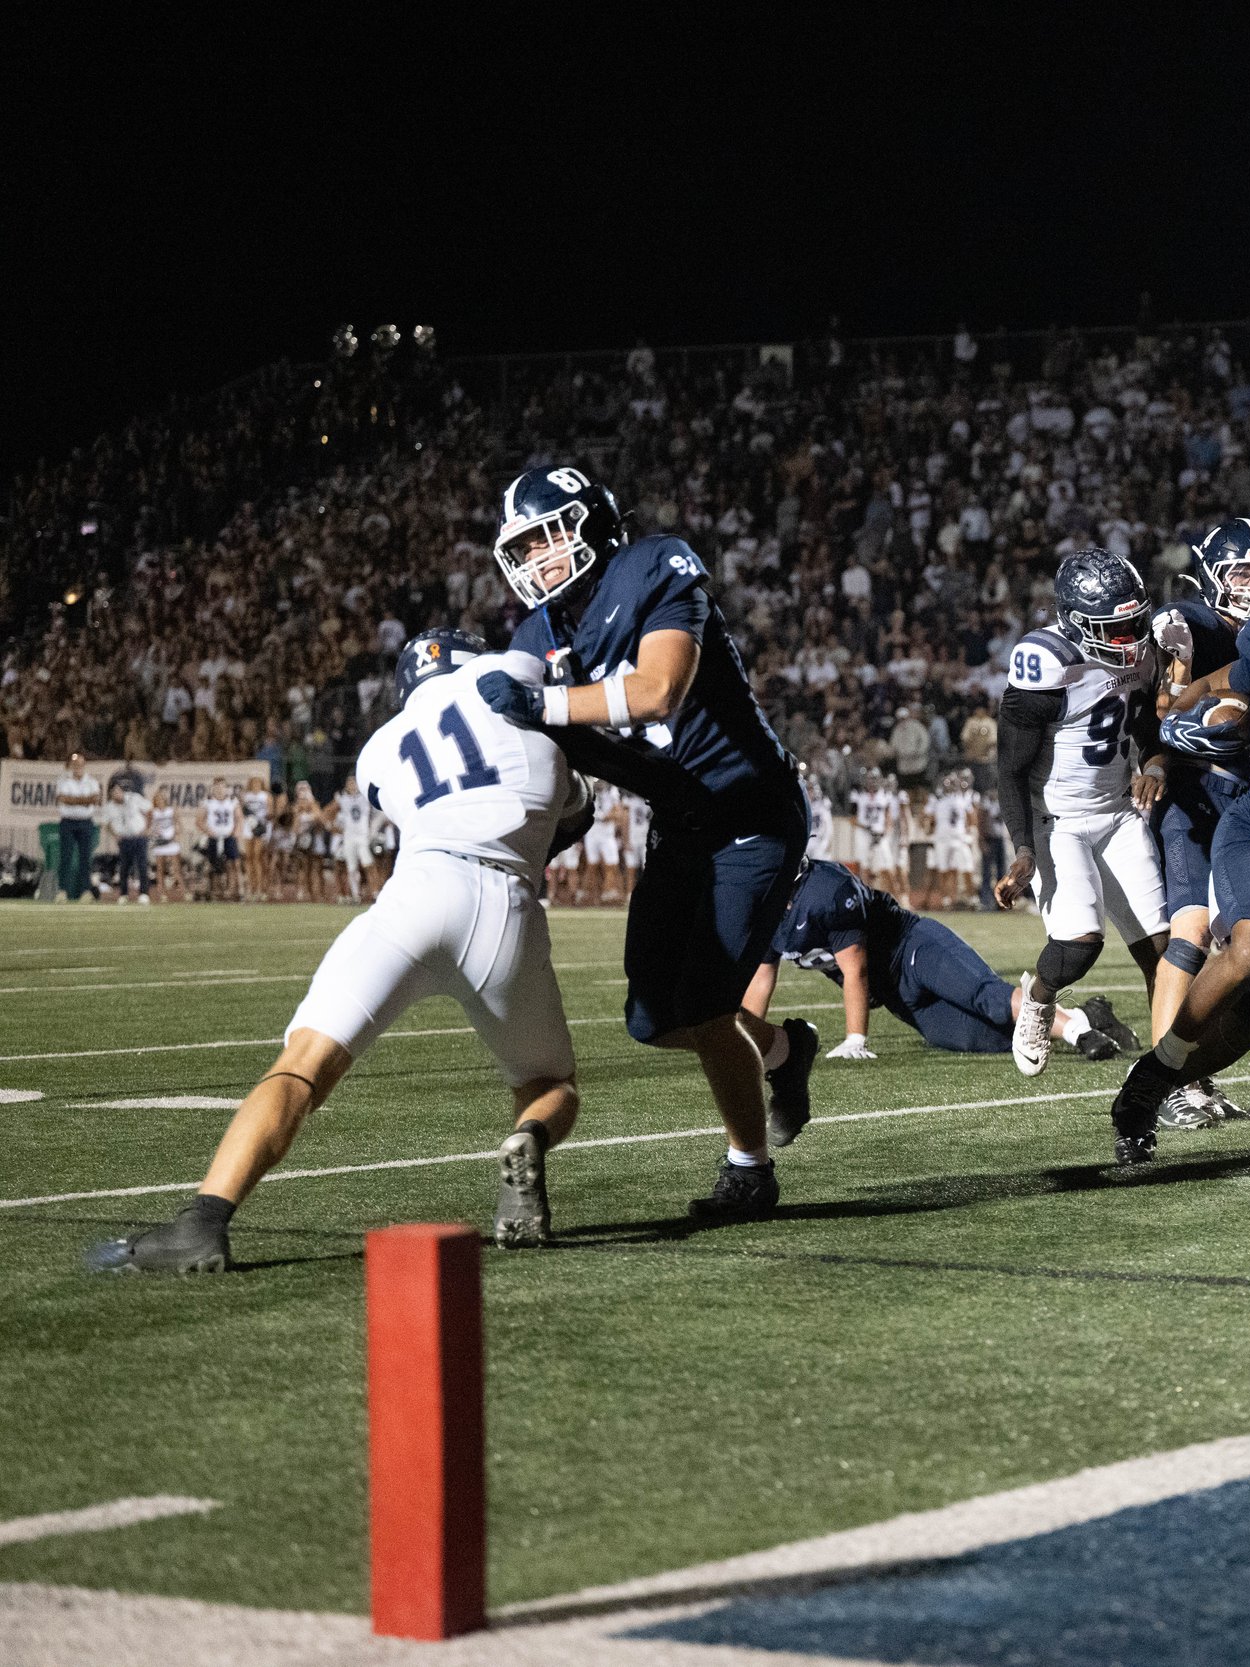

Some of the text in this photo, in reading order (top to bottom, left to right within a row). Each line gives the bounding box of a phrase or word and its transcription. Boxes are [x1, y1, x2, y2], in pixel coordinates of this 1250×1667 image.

[1118, 602, 1138, 613] Riddell
[1015, 650, 1042, 683] 99
[1105, 672, 1140, 690] CHAMPION
[398, 700, 502, 810] 11
